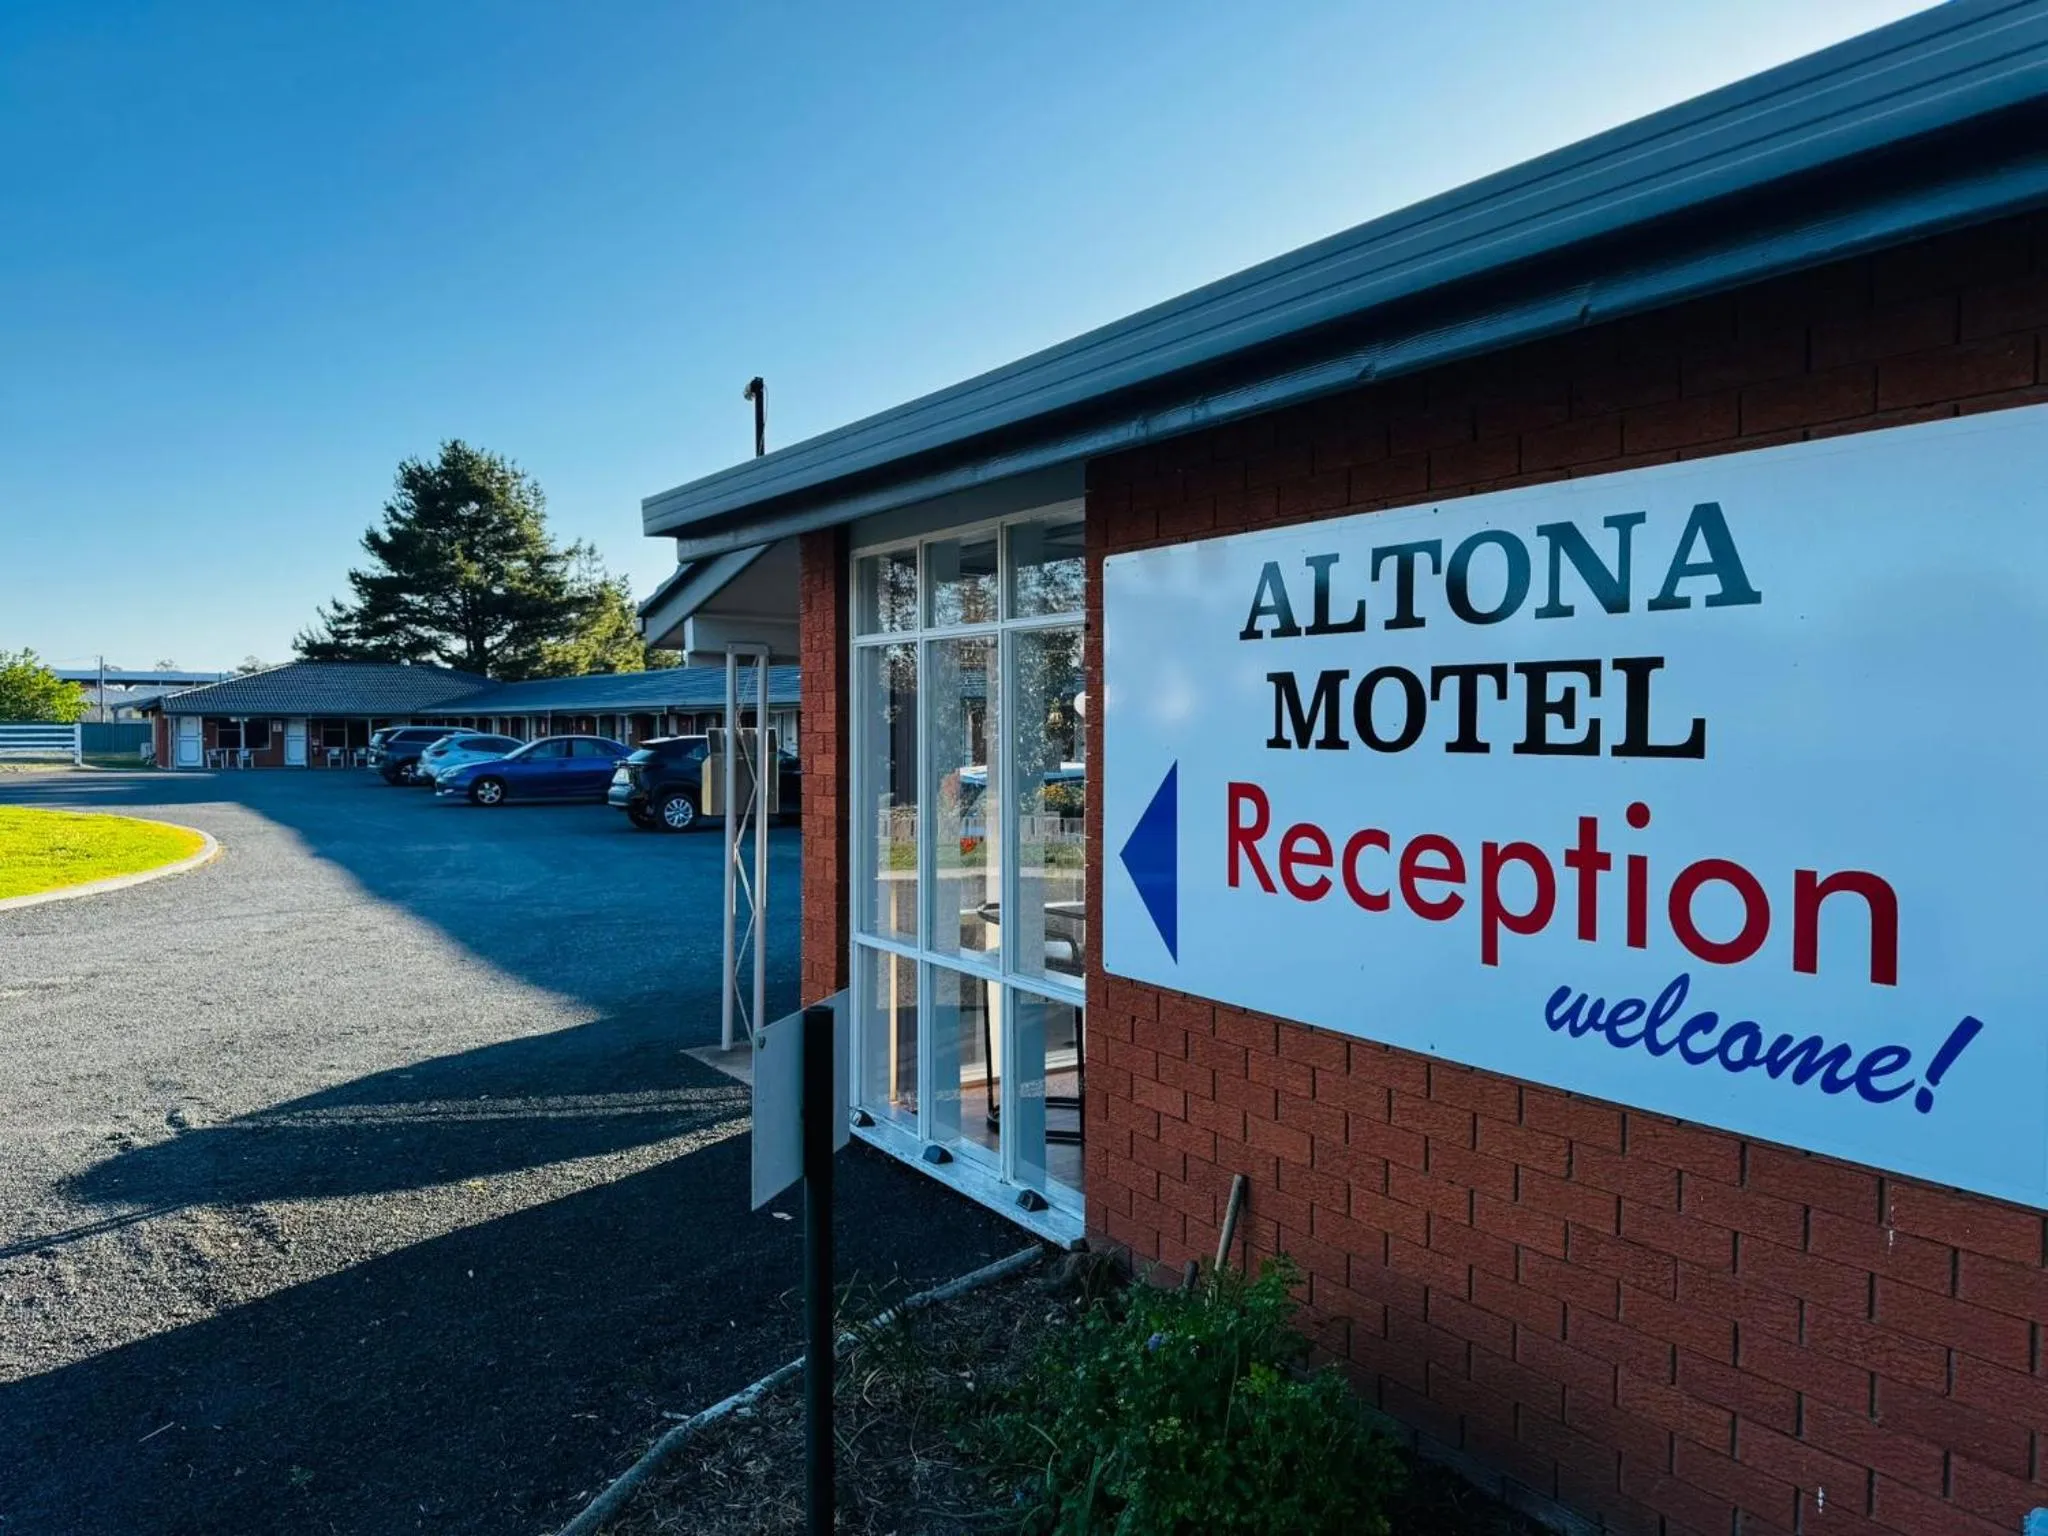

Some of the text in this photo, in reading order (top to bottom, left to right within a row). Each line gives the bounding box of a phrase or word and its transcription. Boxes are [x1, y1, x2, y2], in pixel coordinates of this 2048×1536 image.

[1239, 502, 1762, 641] ALTONA
[1266, 656, 1706, 759] MOTEL
[1228, 782, 1898, 987] Reception
[1545, 973, 1983, 1114] welcome!
